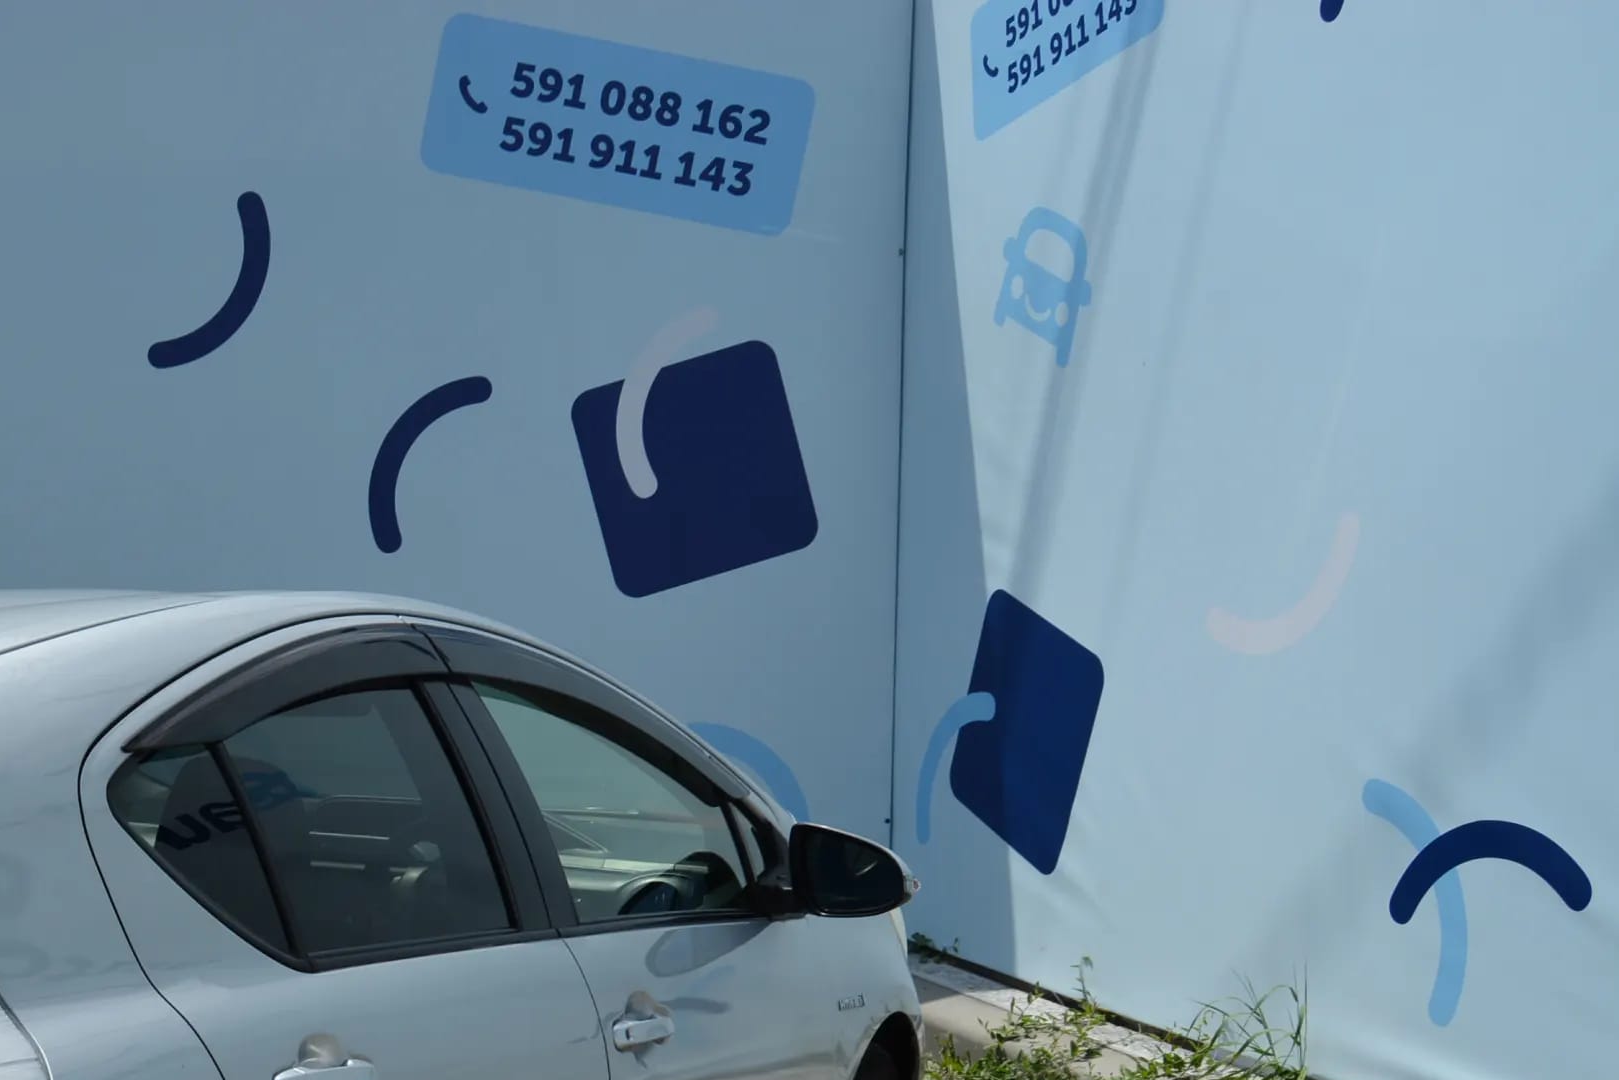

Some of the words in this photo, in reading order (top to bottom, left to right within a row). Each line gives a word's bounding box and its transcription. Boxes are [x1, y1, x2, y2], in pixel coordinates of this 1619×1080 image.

[1005, 0, 1043, 47] 591
[1007, 45, 1045, 93] 591
[1050, 14, 1089, 66] 911
[510, 62, 586, 110] 591
[600, 80, 682, 127] 088
[692, 99, 771, 145] 162
[499, 116, 576, 163] 591
[588, 134, 663, 180] 911
[674, 151, 754, 196] 143
